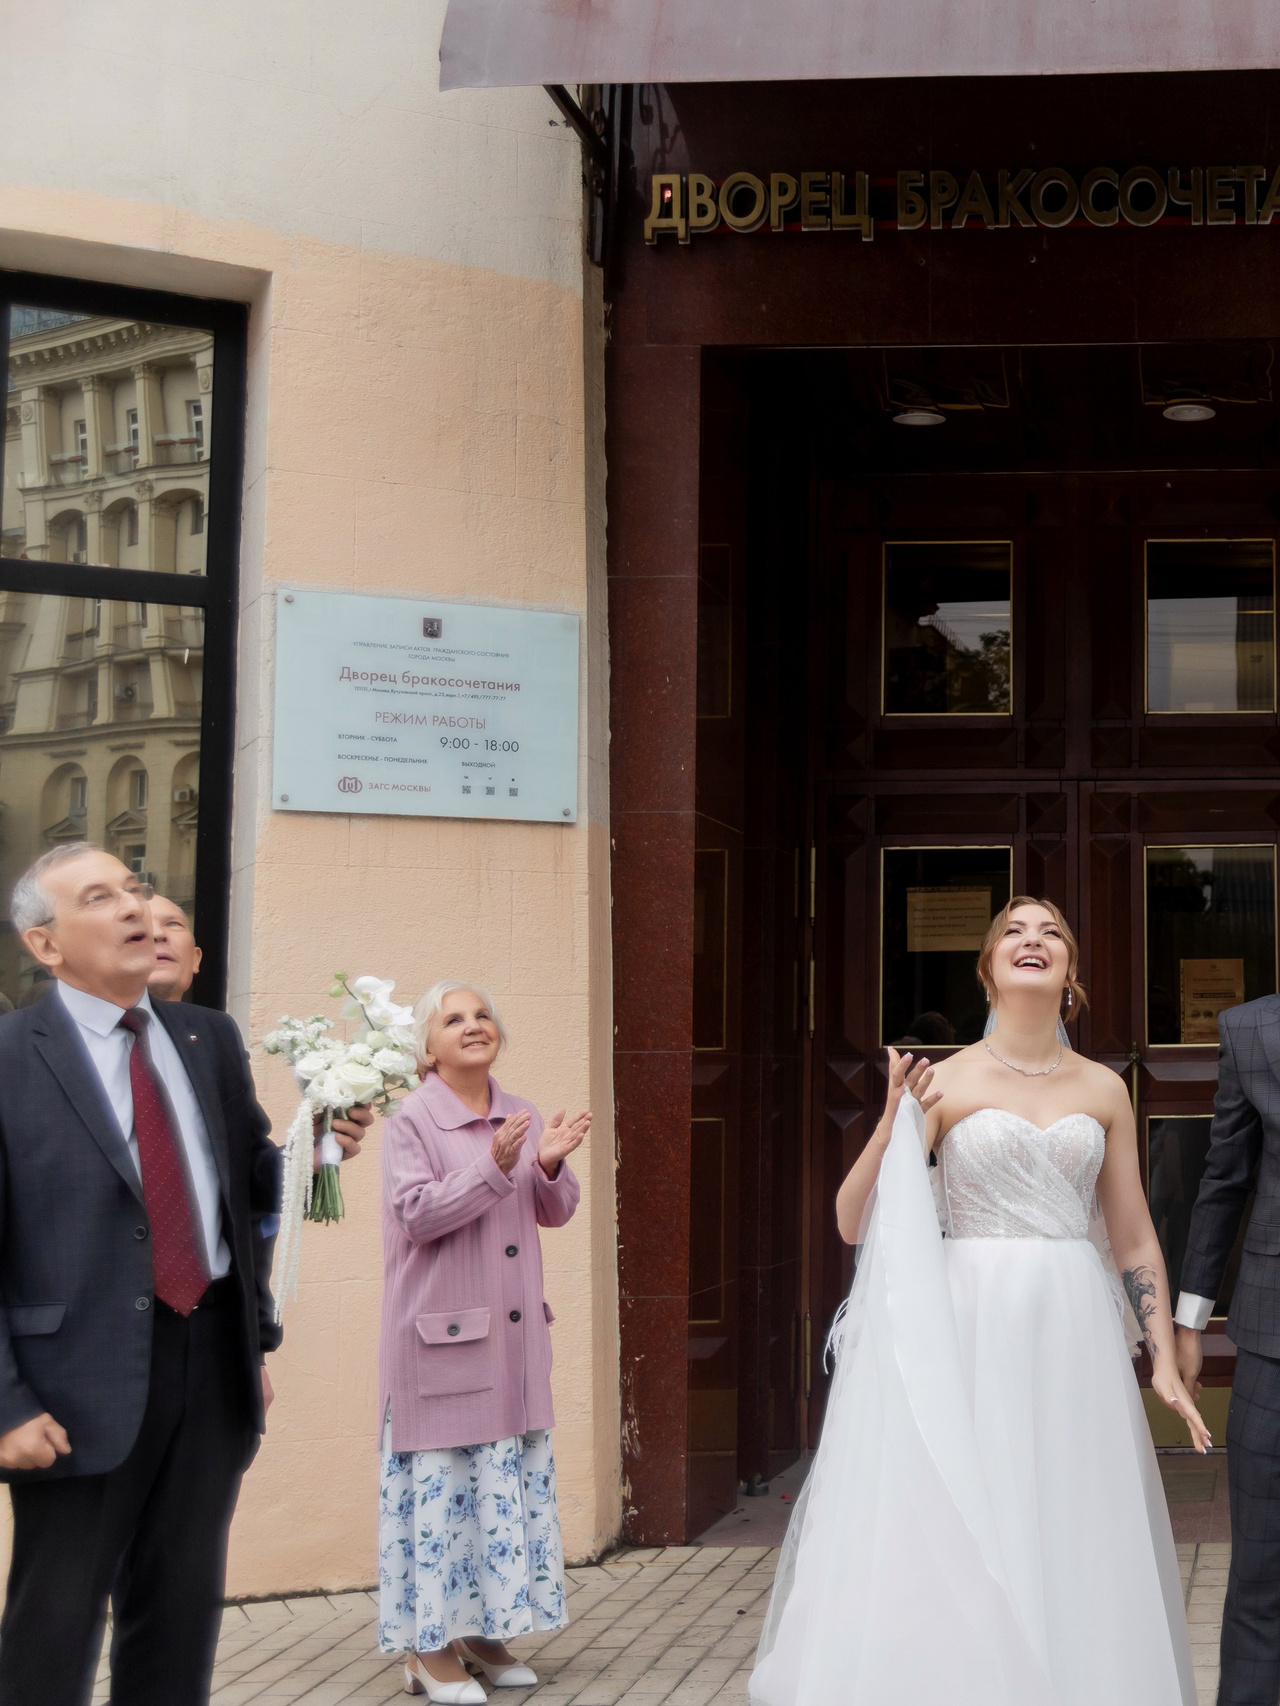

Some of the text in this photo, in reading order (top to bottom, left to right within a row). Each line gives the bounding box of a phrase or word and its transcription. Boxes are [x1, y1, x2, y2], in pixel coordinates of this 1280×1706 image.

[643, 171, 874, 245] ДВОРЕЦ
[352, 641, 388, 649] УПРАВЛЕНИЕ
[433, 647, 476, 655] ГРАЖДАНСКОГО
[339, 666, 521, 692] Дворец бракосочетания
[374, 711, 486, 730] РЕЖИМ РАБОТЫ
[440, 736, 470, 750] 9:00
[484, 739, 520, 753] 18:00
[338, 754, 379, 762] ВОСКРЕСЕНЬЕ
[384, 756, 429, 764] ПОНЕДЕЛЬНИК
[368, 782, 432, 793] ЗАГС МОСКВЫ
